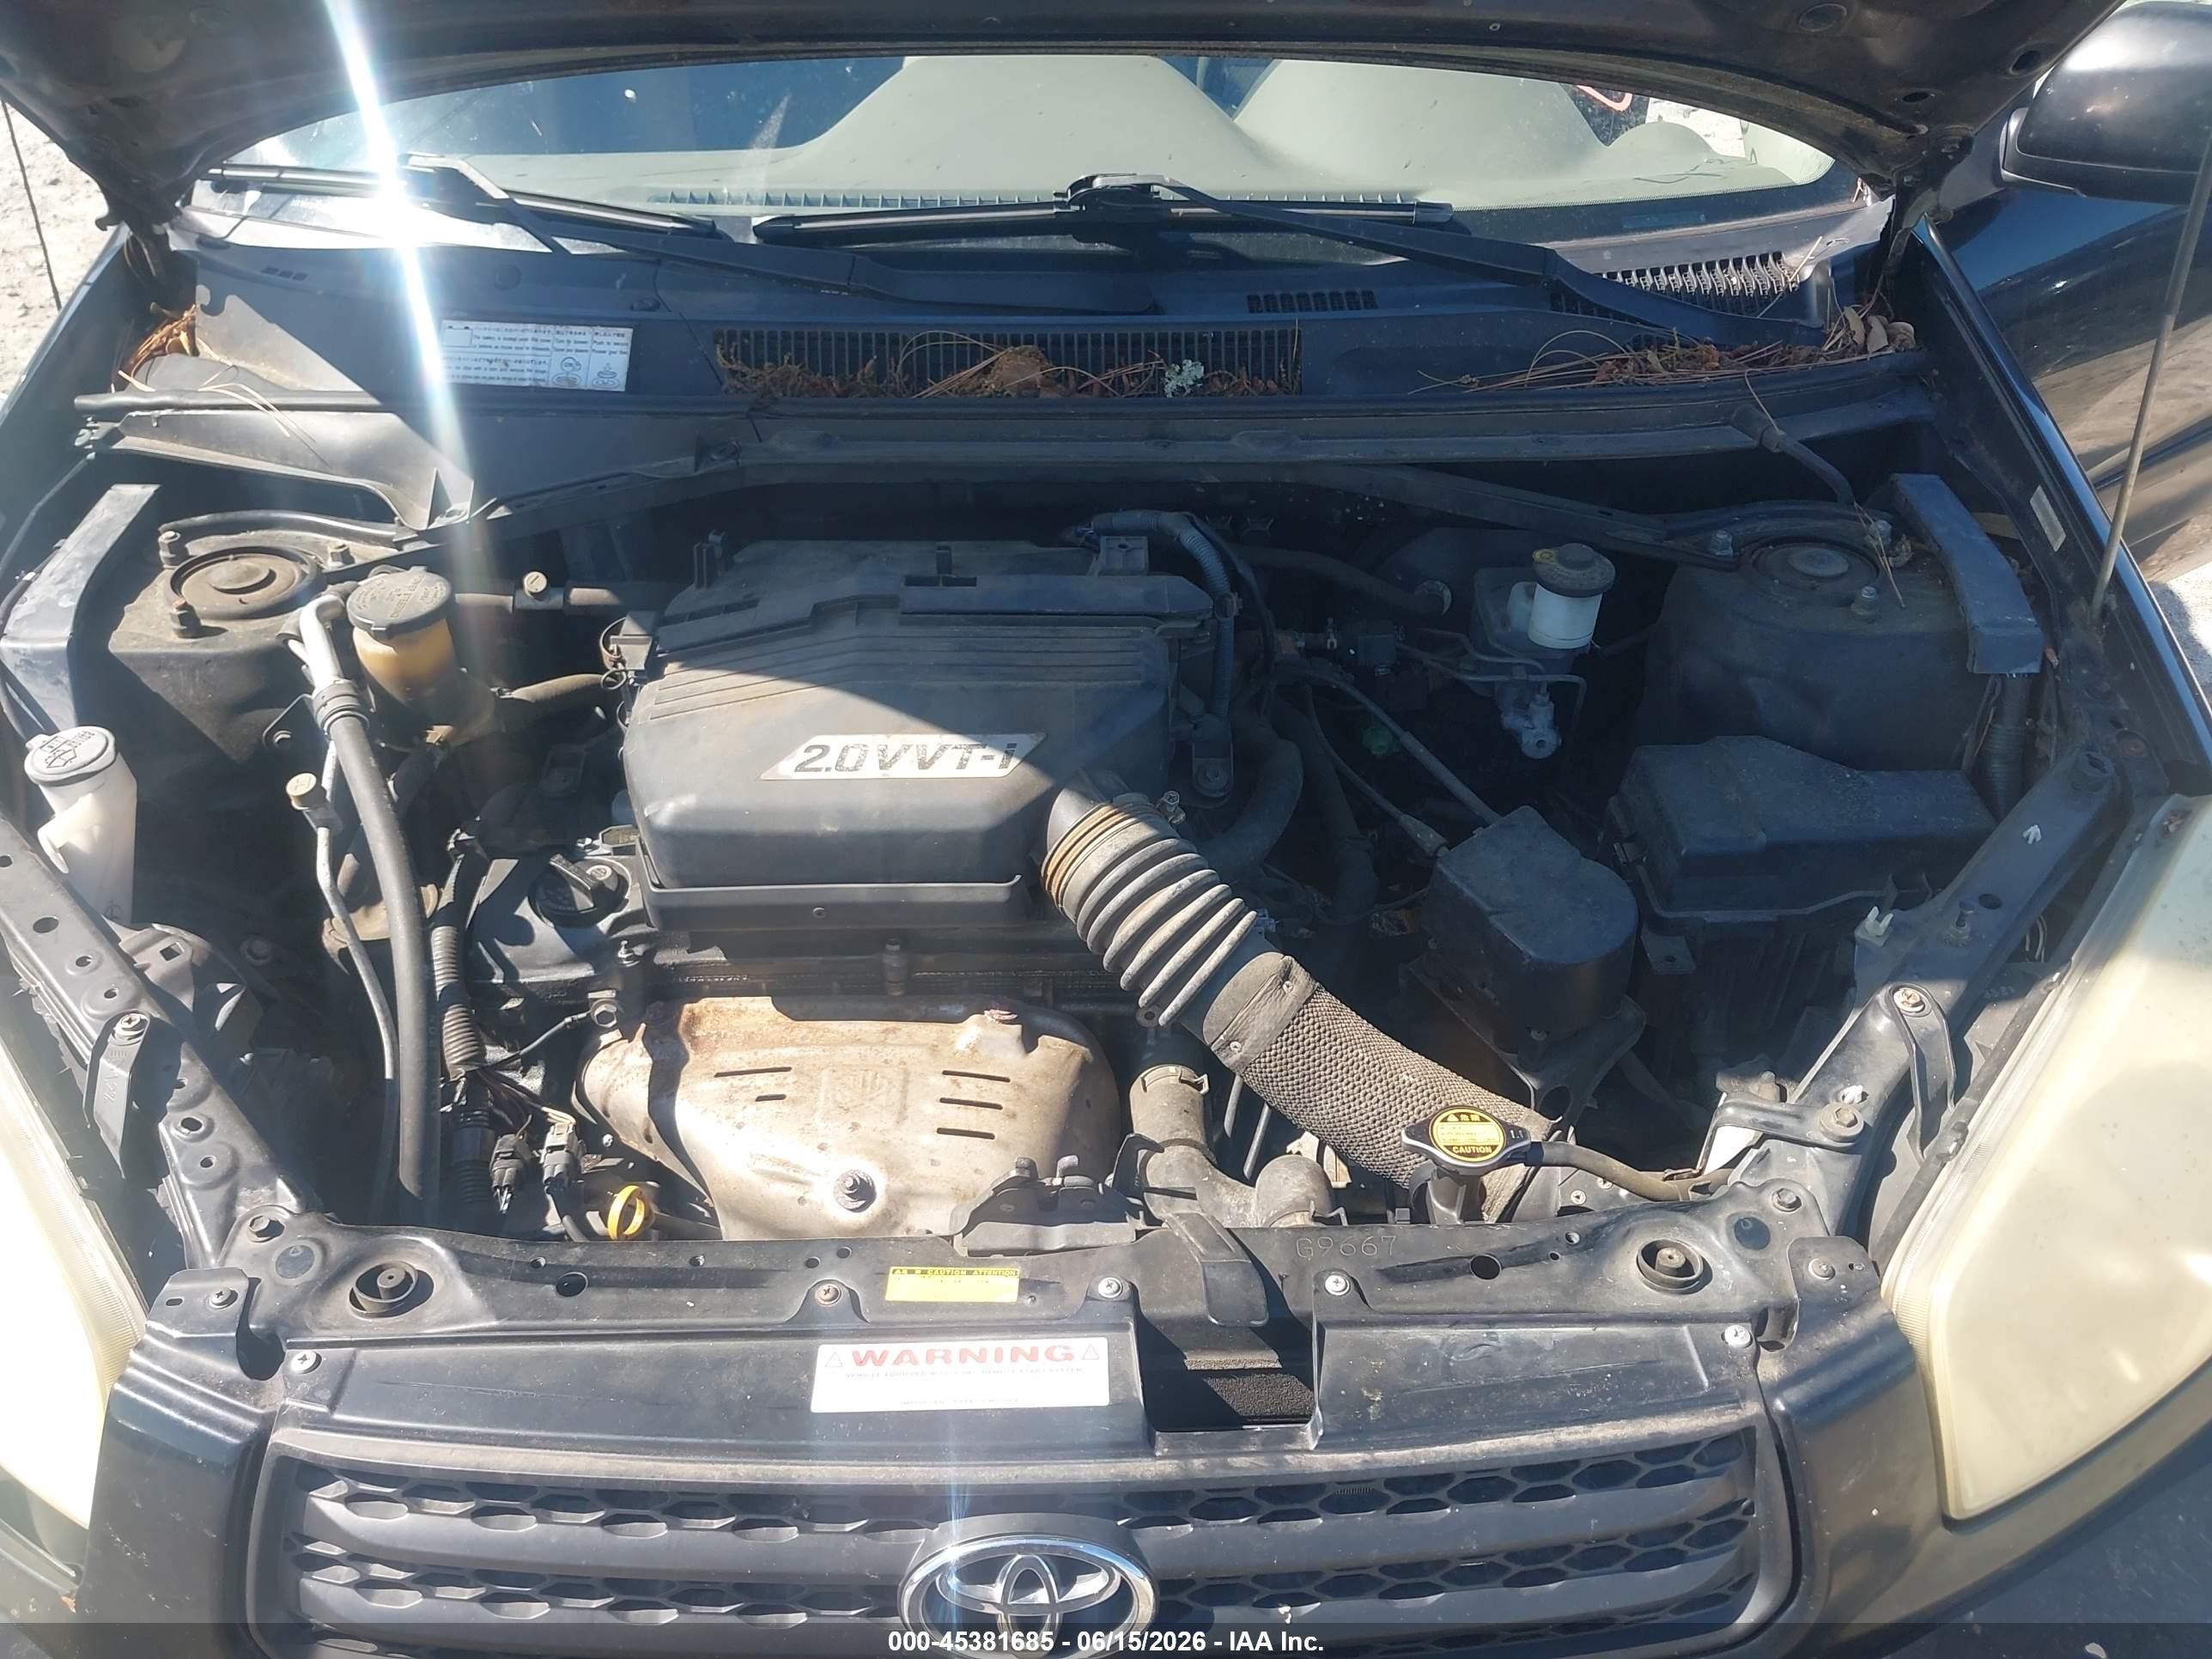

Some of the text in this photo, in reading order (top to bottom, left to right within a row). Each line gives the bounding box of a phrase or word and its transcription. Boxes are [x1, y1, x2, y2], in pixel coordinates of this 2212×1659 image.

[1452, 1146, 1492, 1154] CAUTION
[1296, 1236, 1396, 1258] G9667
[852, 1345, 1075, 1367] WARNING
